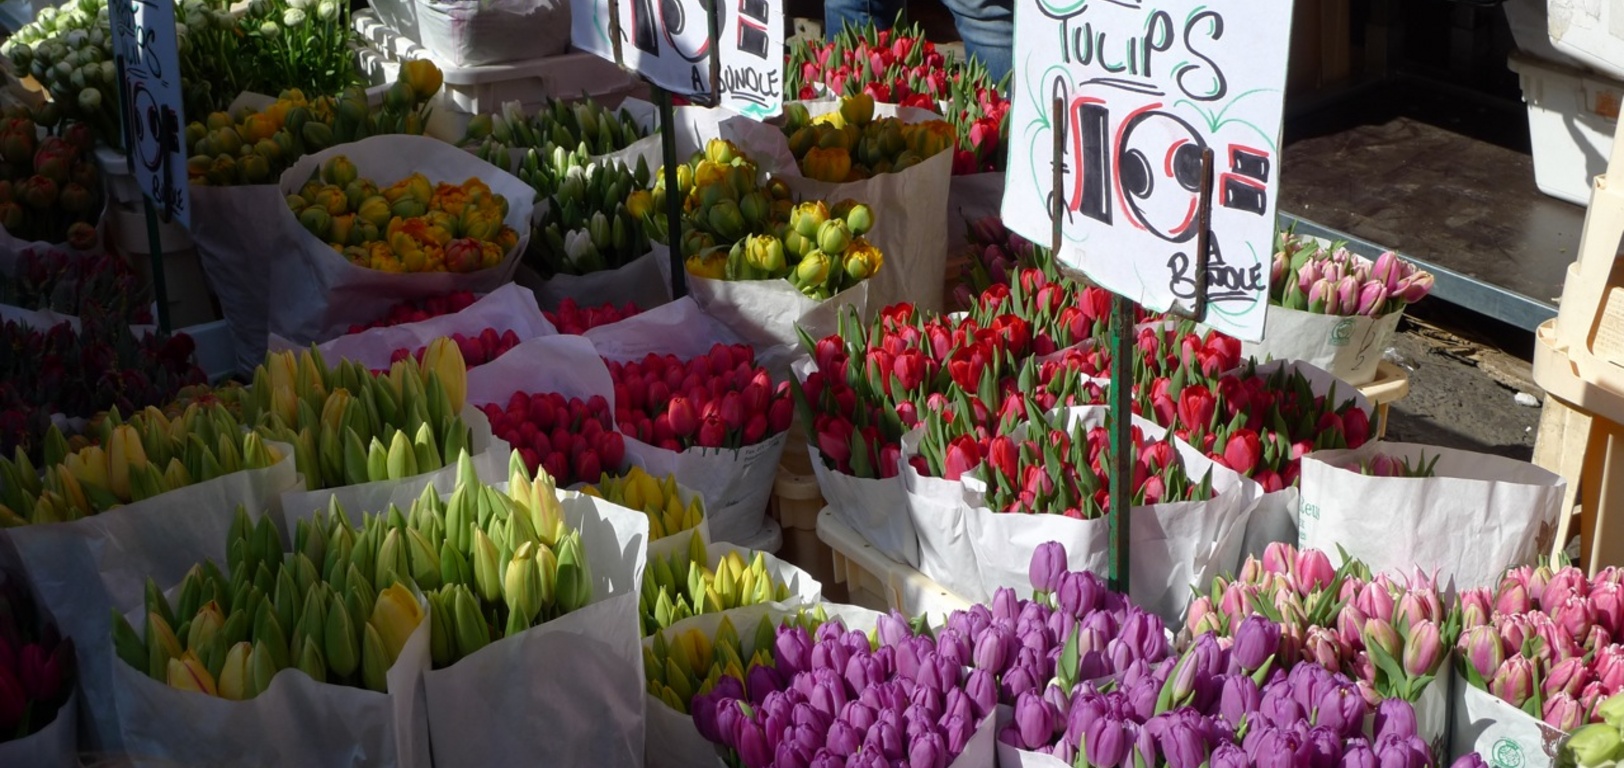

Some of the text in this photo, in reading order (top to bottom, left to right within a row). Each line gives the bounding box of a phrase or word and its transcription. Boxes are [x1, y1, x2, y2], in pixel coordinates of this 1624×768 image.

[1036, 0, 1227, 101] TULIPS
[691, 65, 705, 92] A
[1207, 229, 1226, 265] A
[1167, 252, 1266, 299] BNDLE
